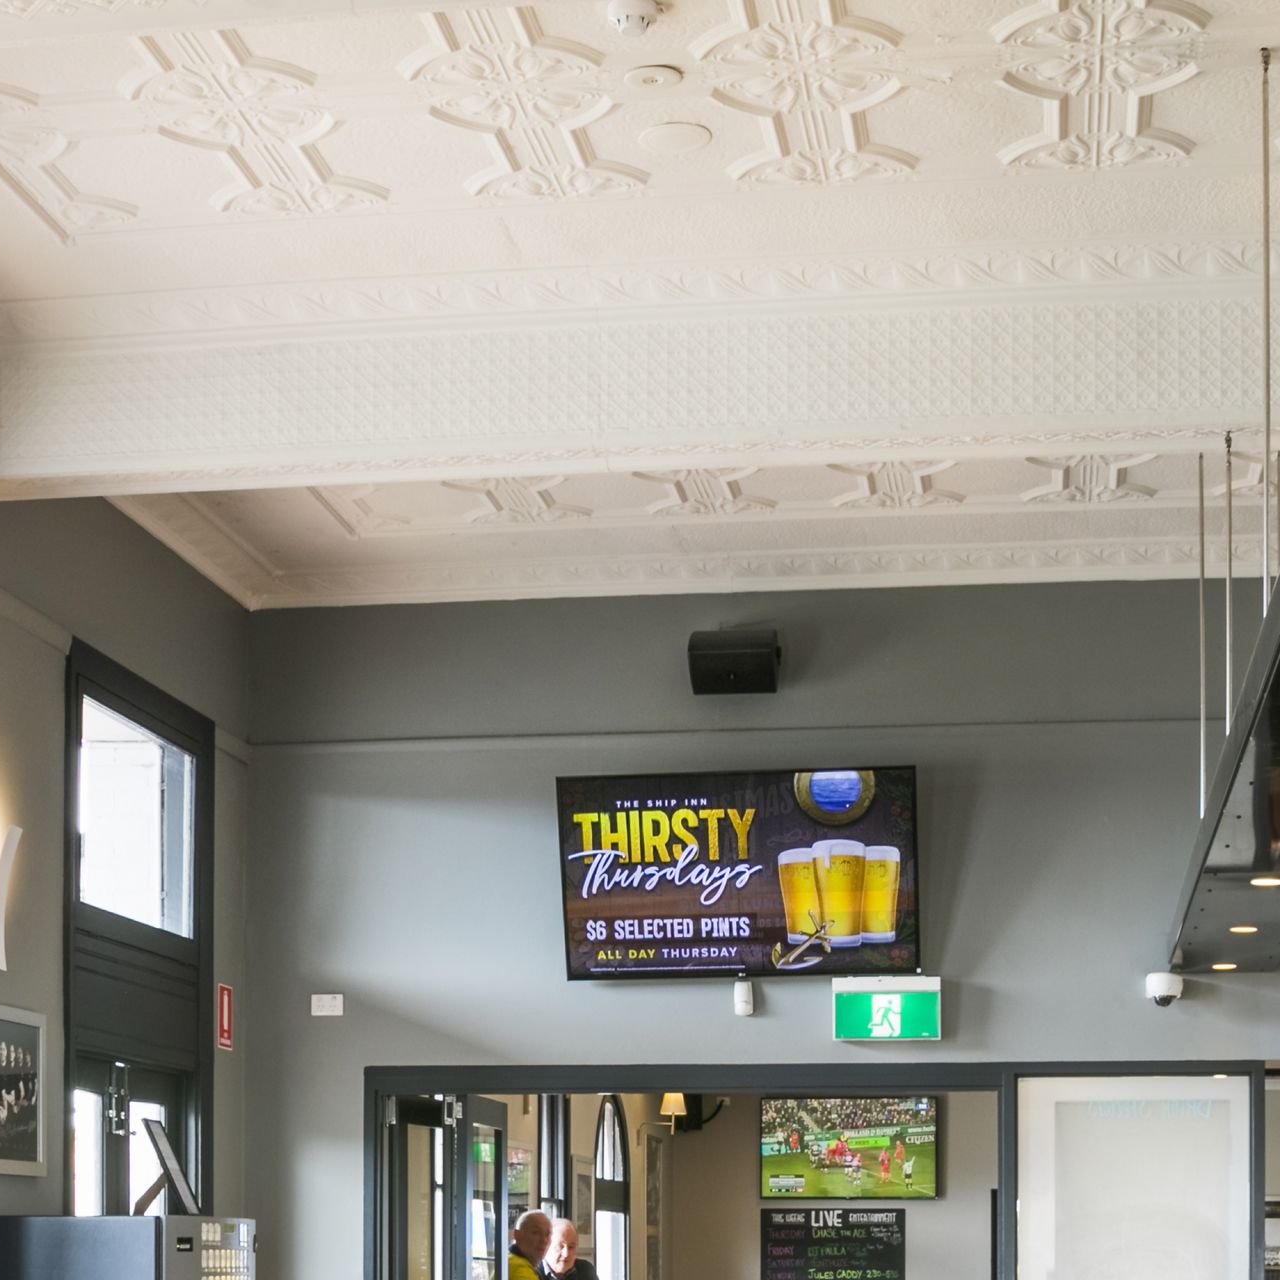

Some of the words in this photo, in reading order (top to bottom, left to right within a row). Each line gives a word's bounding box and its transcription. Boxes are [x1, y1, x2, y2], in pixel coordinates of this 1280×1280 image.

[616, 800, 639, 808] THE
[648, 799, 677, 808] SHIP
[684, 798, 708, 807] INN
[573, 808, 756, 864] THIRSTY
[568, 844, 763, 906] Thursdays
[586, 919, 607, 941] $6
[614, 917, 694, 940] SELECTED
[701, 916, 750, 939] PINTS
[597, 949, 623, 960] ALL
[628, 948, 656, 960] DAY
[662, 946, 738, 959] THURSDAY
[811, 1210, 843, 1227] LIVE
[768, 1243, 794, 1256] FRIDAY
[808, 1268, 834, 1280] JULES
